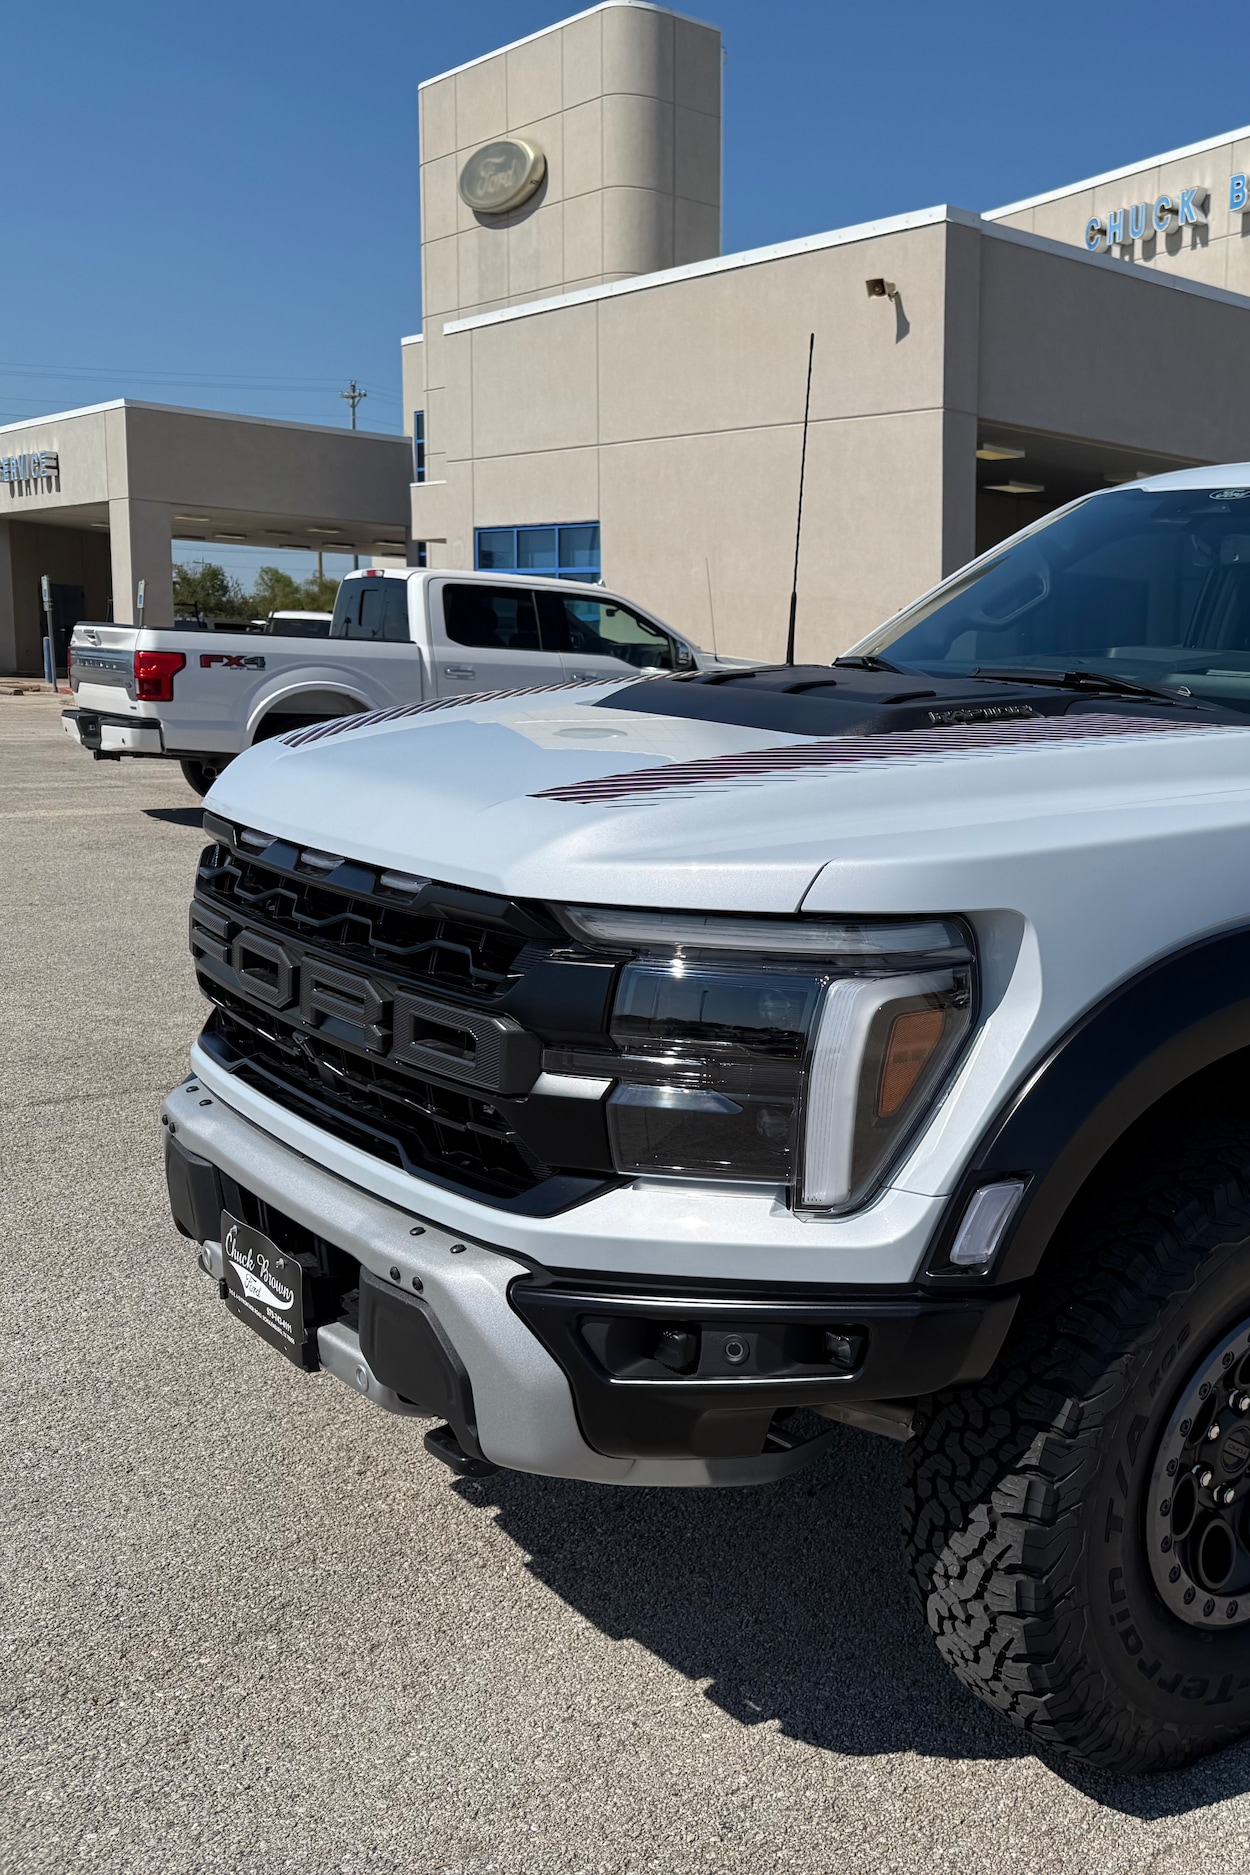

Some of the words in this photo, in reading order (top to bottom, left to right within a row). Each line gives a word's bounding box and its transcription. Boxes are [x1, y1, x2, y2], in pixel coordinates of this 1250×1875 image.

[1085, 186, 1206, 252] CHUCK
[200, 654, 265, 669] FX4
[189, 899, 540, 1098] FORD
[225, 1232, 255, 1271] Chuck
[257, 1253, 294, 1301] Brown
[244, 1274, 262, 1298] Ford
[1104, 1414, 1151, 1544] T/A
